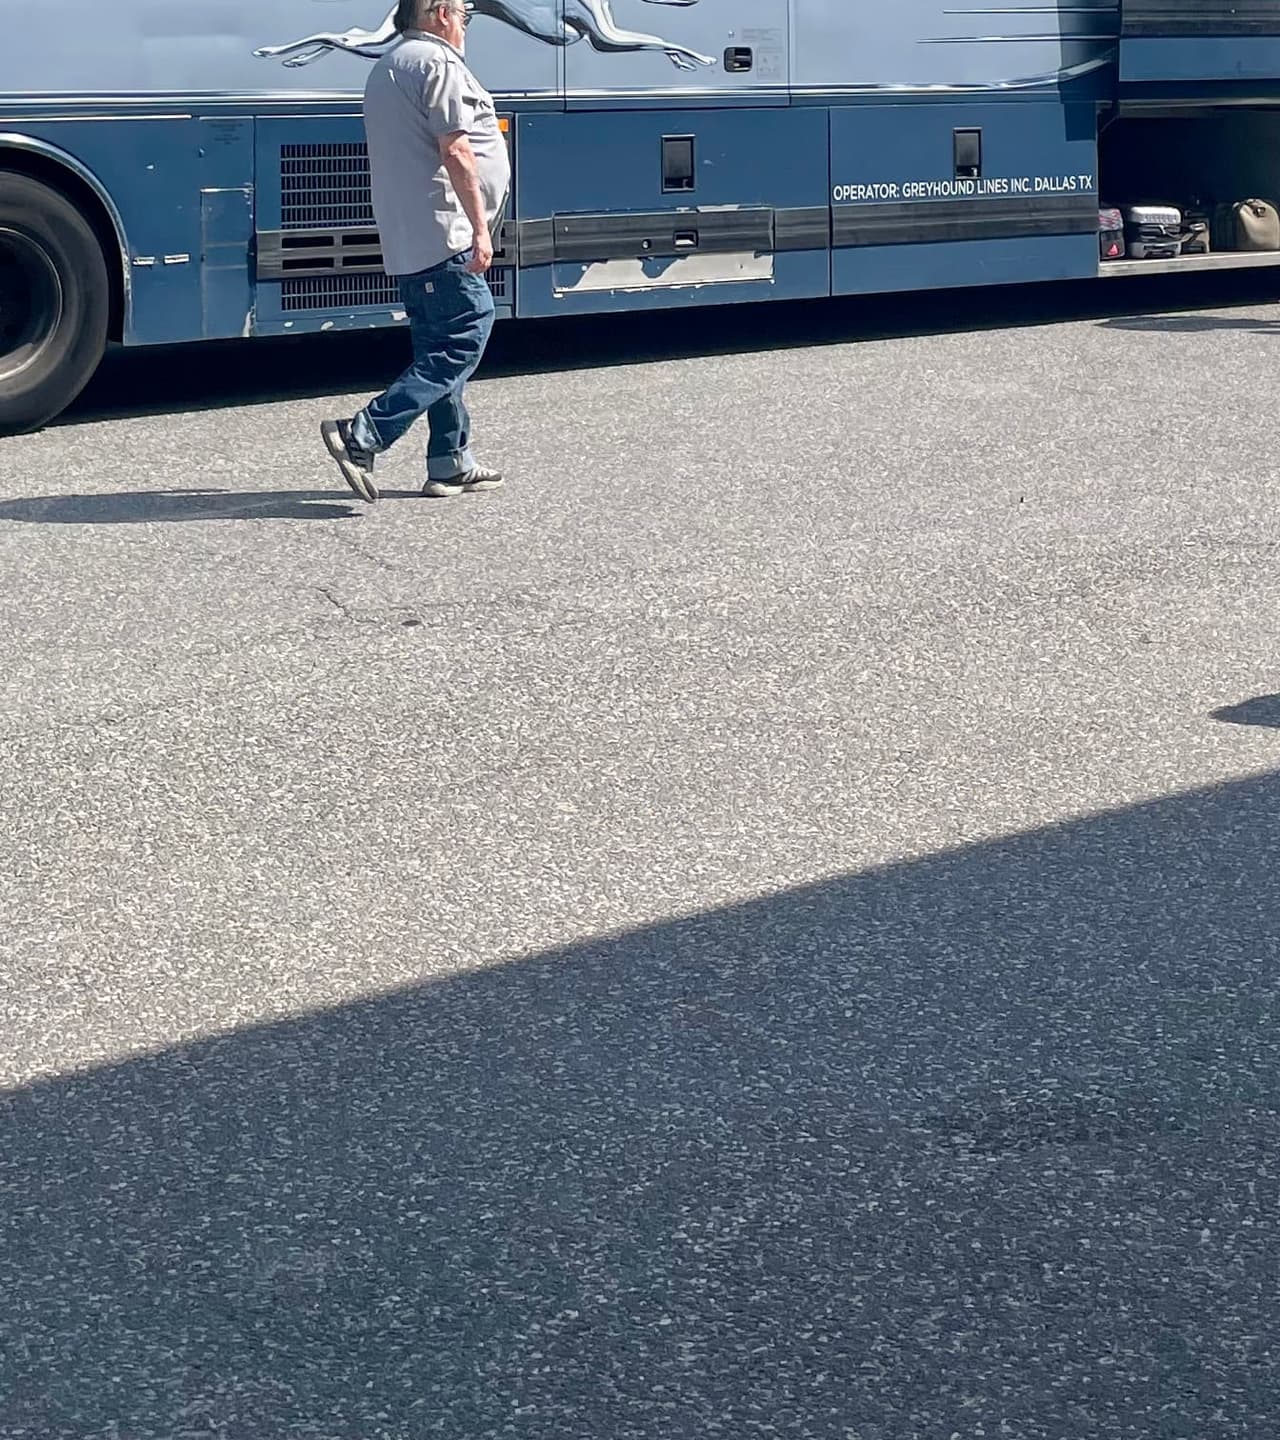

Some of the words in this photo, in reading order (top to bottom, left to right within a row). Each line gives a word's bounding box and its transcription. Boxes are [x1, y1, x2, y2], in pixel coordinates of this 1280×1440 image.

[833, 183, 901, 201] OPERATOR:
[902, 179, 975, 198] GREYHOUND
[977, 178, 1009, 194] LINES
[1035, 175, 1076, 192] DALLAS
[1079, 174, 1093, 190] TX
